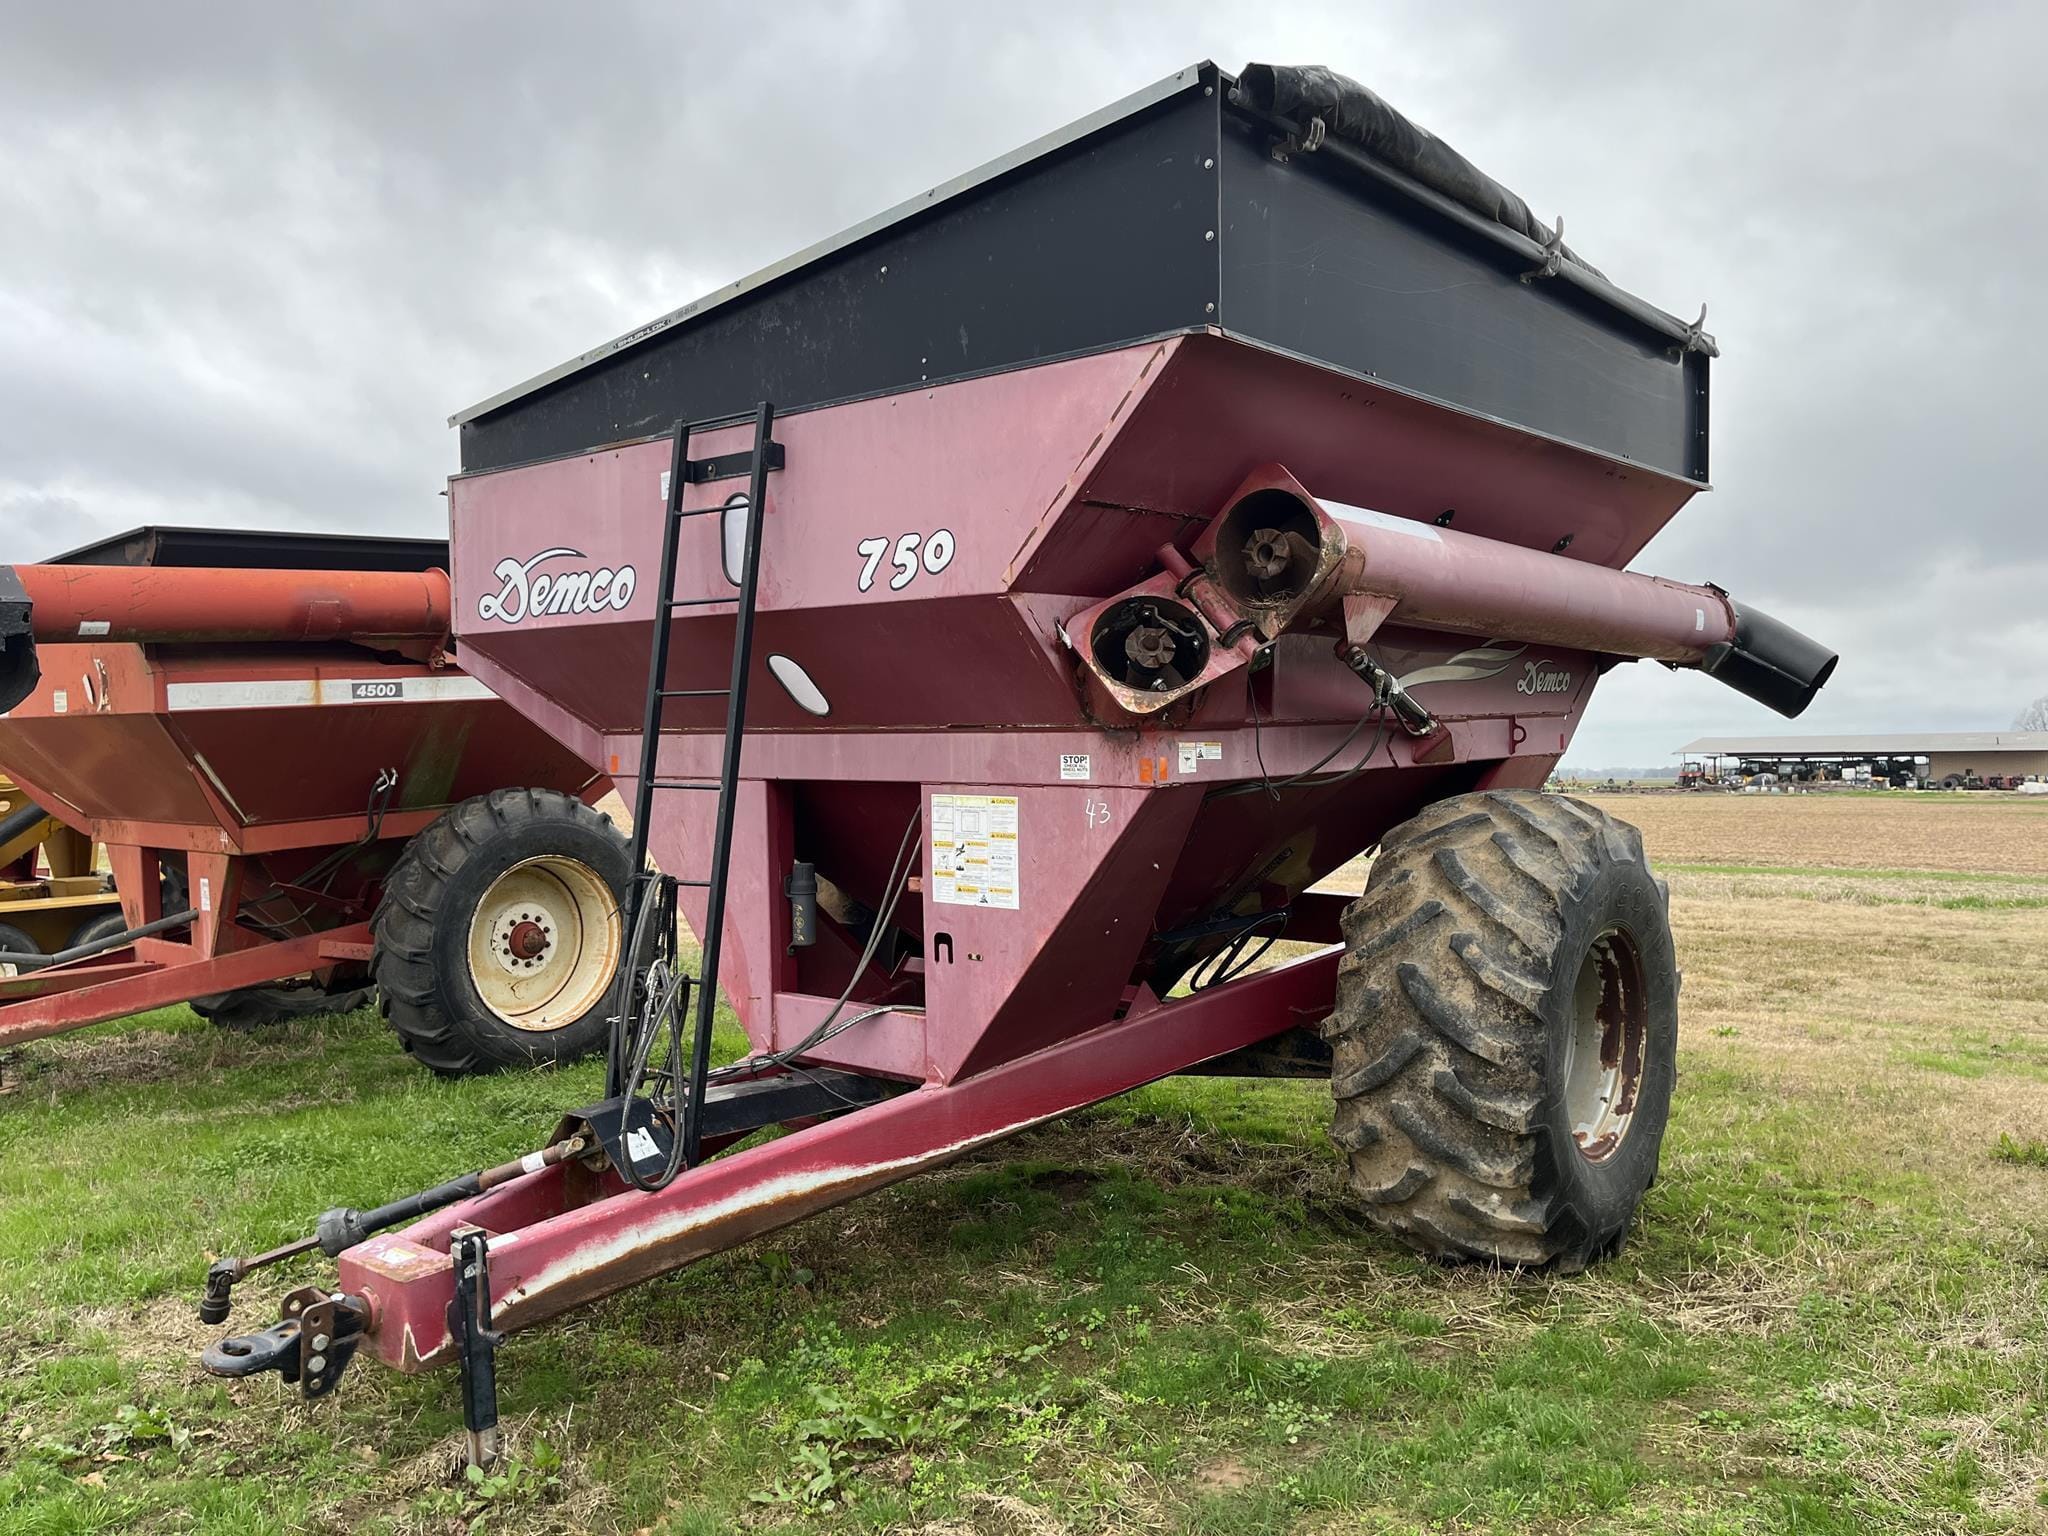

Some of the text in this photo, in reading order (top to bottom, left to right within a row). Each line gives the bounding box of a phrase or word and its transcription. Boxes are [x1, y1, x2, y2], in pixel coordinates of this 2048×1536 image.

[857, 529, 956, 593] 750
[478, 546, 636, 624] Demco
[356, 684, 396, 697] 4500
[1517, 659, 1571, 696] Demco
[1085, 798, 1111, 829] 43
